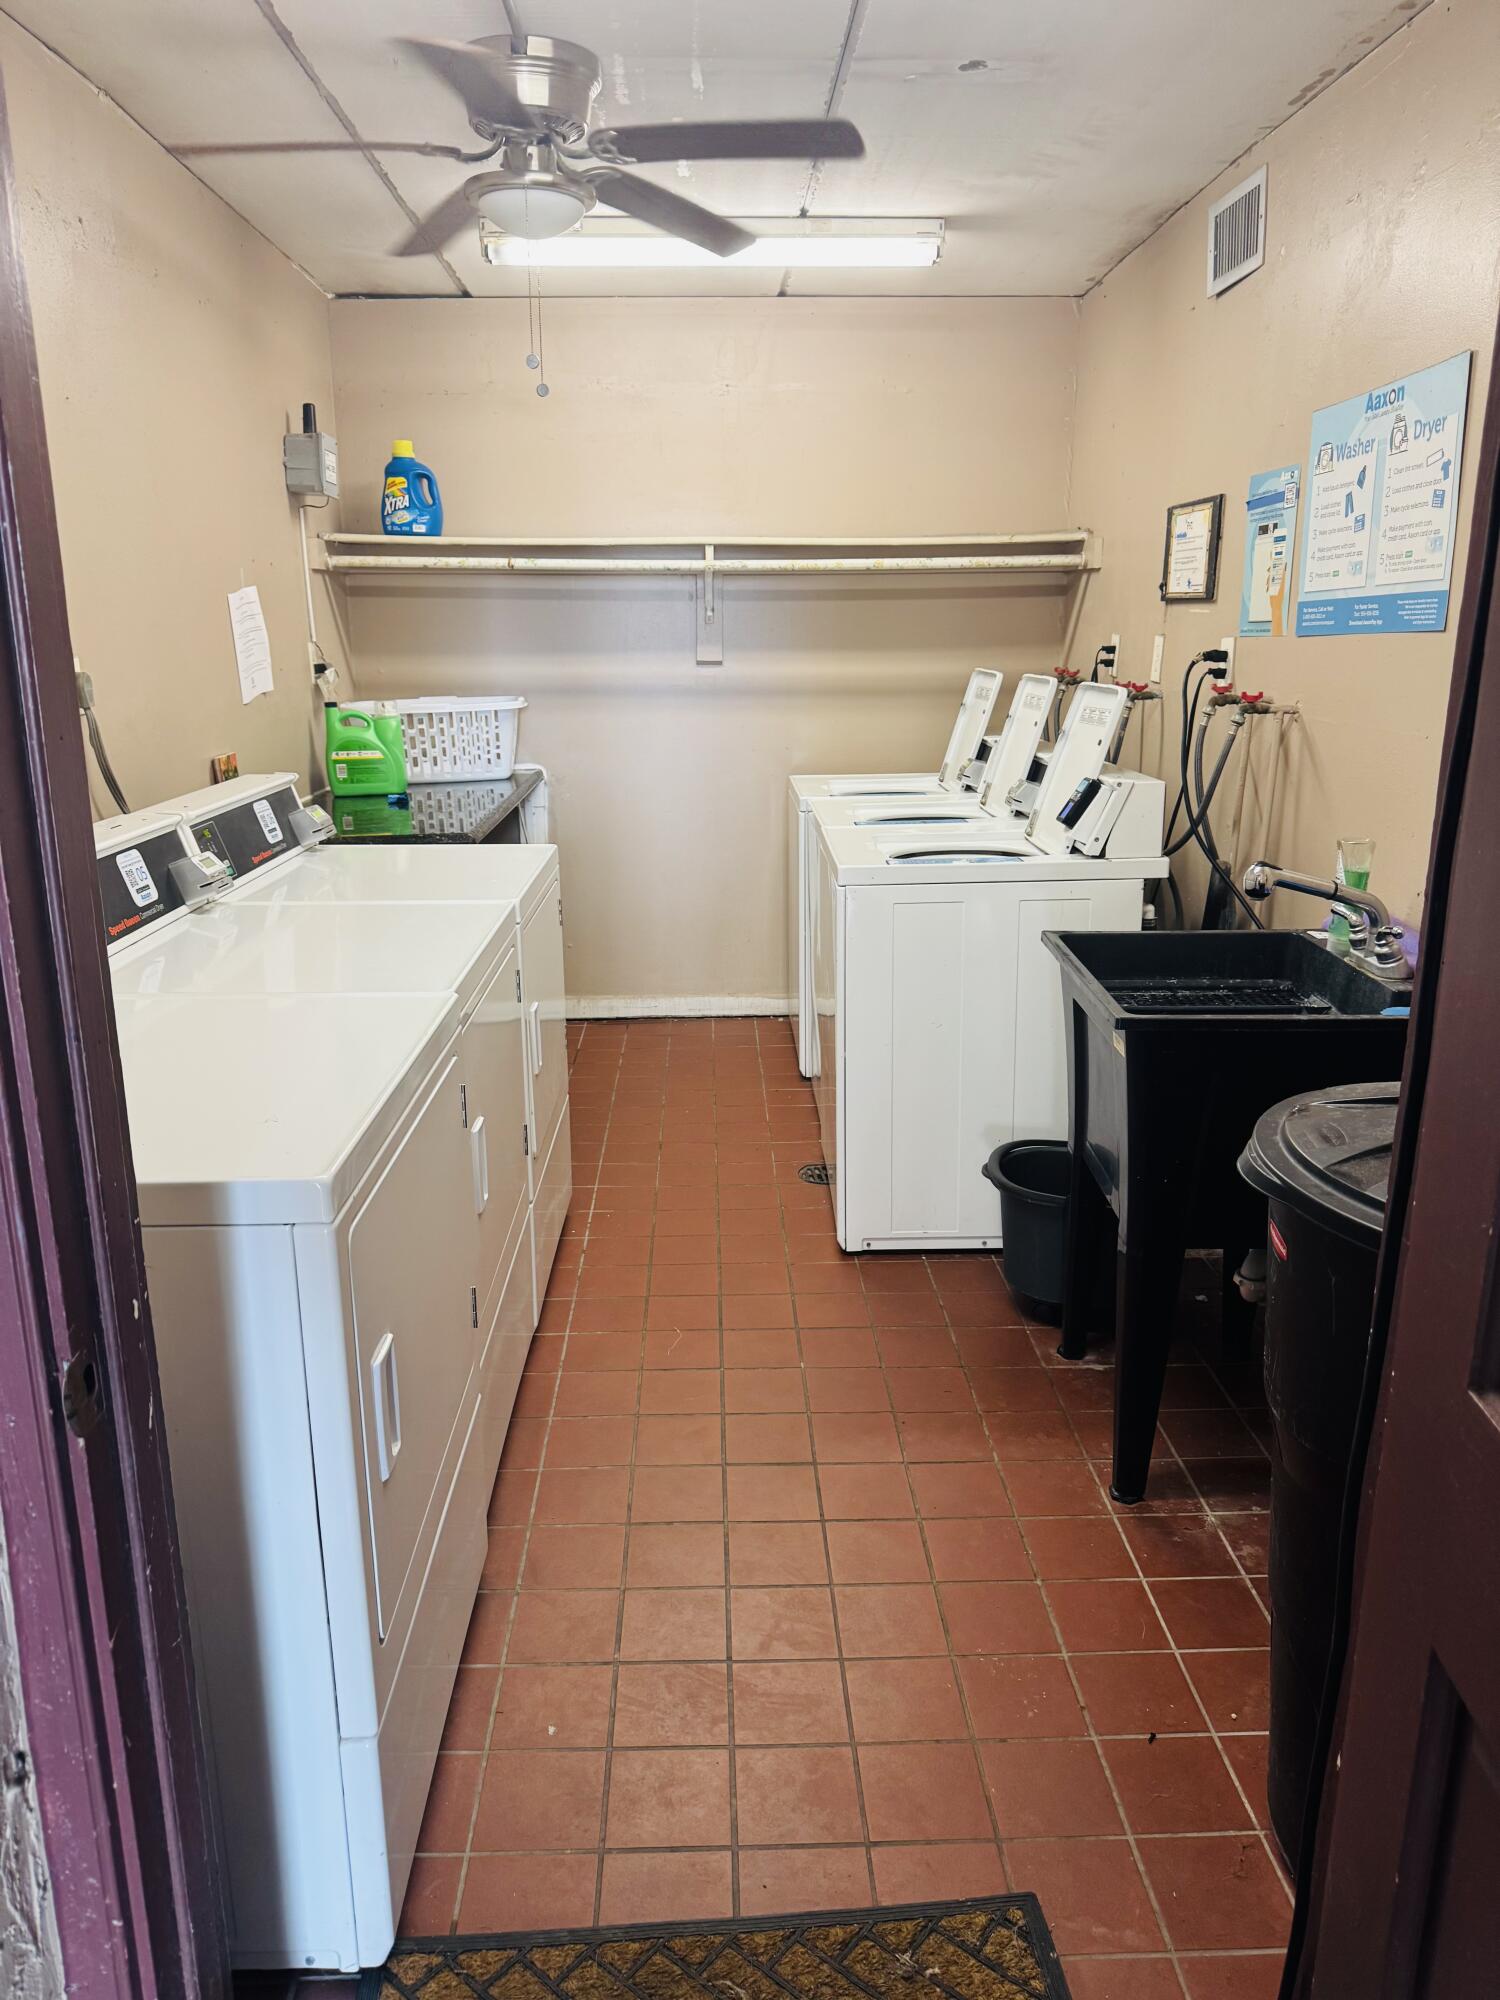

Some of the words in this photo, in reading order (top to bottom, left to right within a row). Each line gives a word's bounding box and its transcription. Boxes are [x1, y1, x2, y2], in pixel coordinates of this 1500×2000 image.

[1365, 385, 1405, 414] Aaxon
[1414, 416, 1448, 442] Dryer
[1335, 437, 1376, 463] Washer
[1385, 486, 1391, 498] 2
[384, 494, 410, 516] XTRA
[1383, 503, 1390, 517] 3
[1313, 507, 1320, 519] 2
[1381, 527, 1387, 540] 4
[1379, 552, 1386, 566] 5
[1308, 571, 1314, 583] 5
[108, 919, 127, 937] Speed
